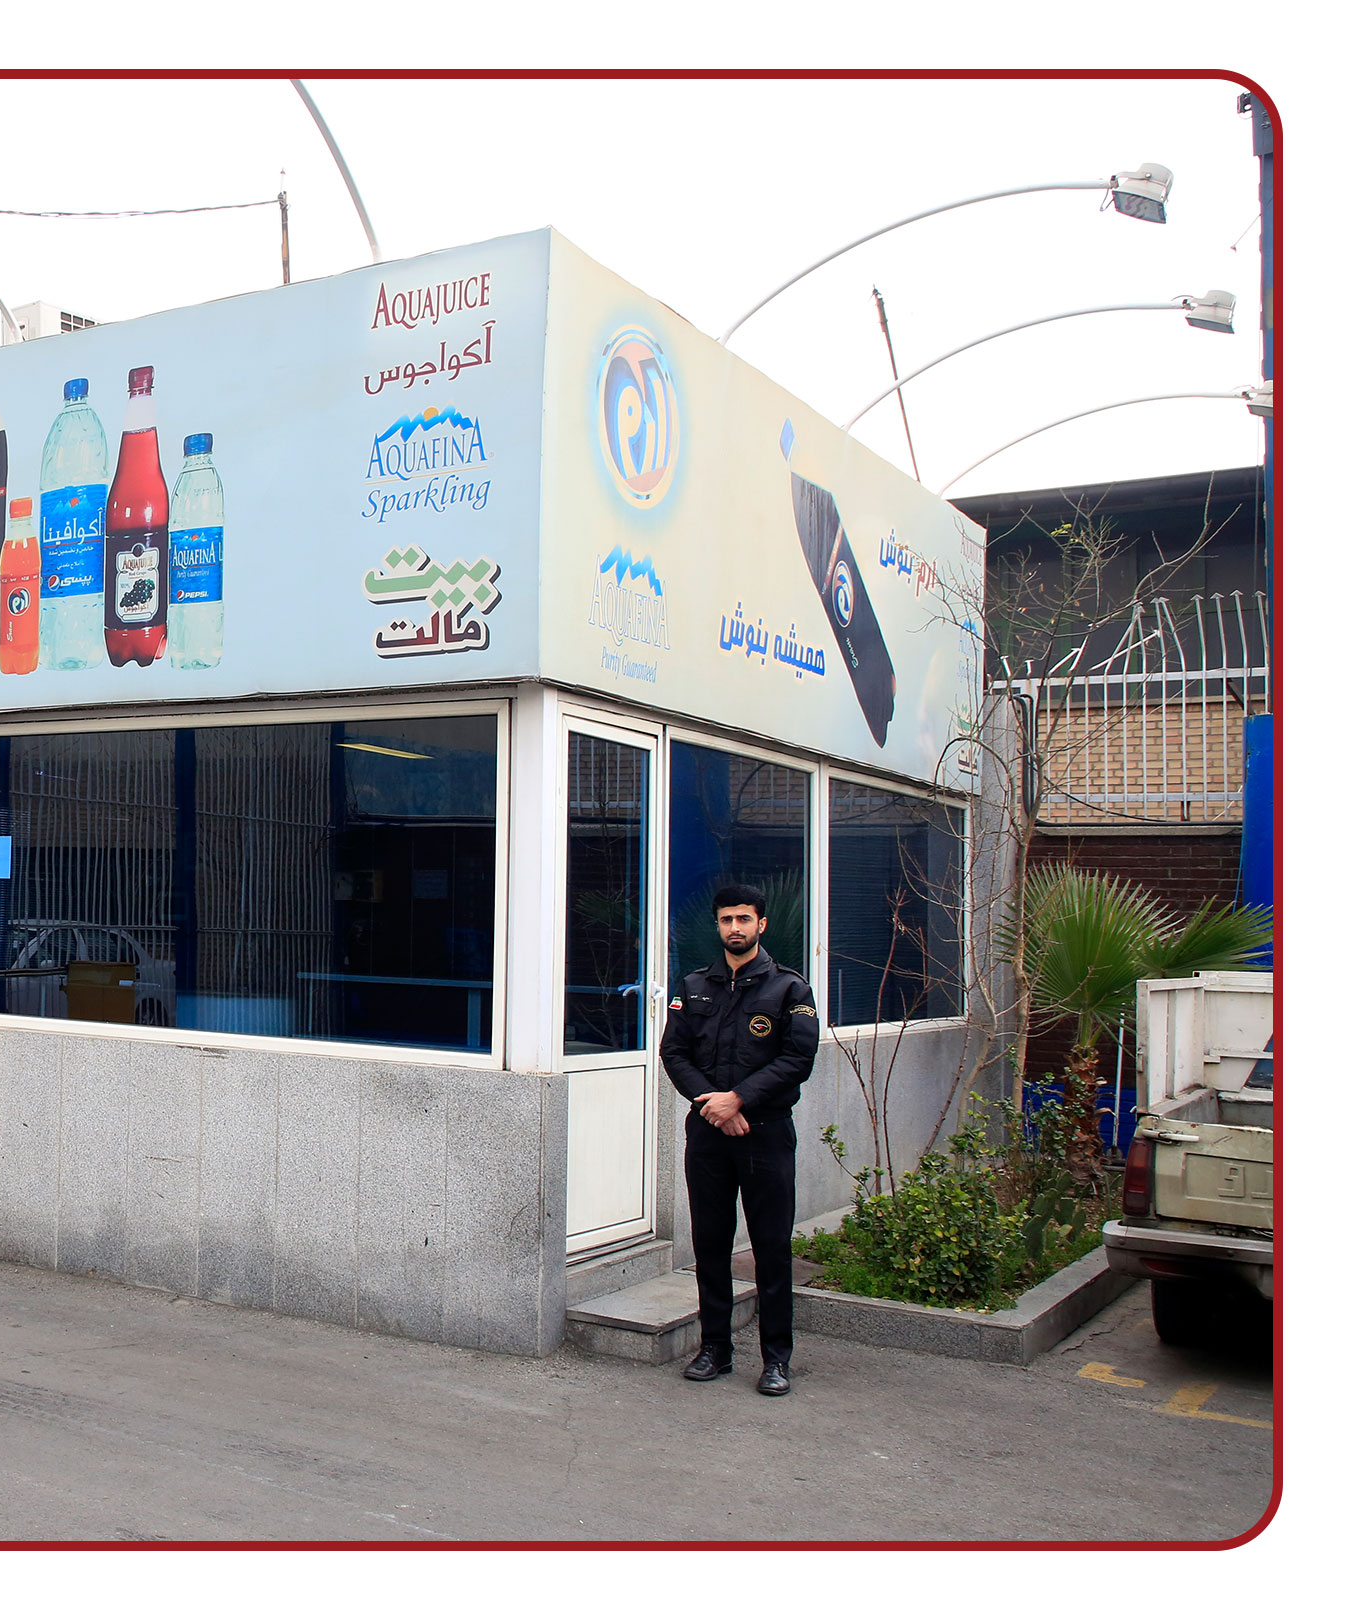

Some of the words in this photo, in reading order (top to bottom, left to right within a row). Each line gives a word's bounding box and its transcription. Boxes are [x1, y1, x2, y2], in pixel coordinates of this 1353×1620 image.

[371, 271, 491, 330] AQUAJUICE
[363, 319, 496, 396] آکواجوس
[365, 416, 488, 482] AQUAFINA
[43, 507, 104, 545] آکوافینا
[362, 473, 491, 523] Sparkling
[172, 541, 216, 569] AQUAFINA
[373, 603, 489, 657] مالت
[588, 554, 670, 651] AQUAFINA
[720, 601, 768, 665] بنوش
[774, 621, 827, 679] همیشه
[601, 646, 620, 675] Purity
[623, 649, 658, 683] Guaranteed
